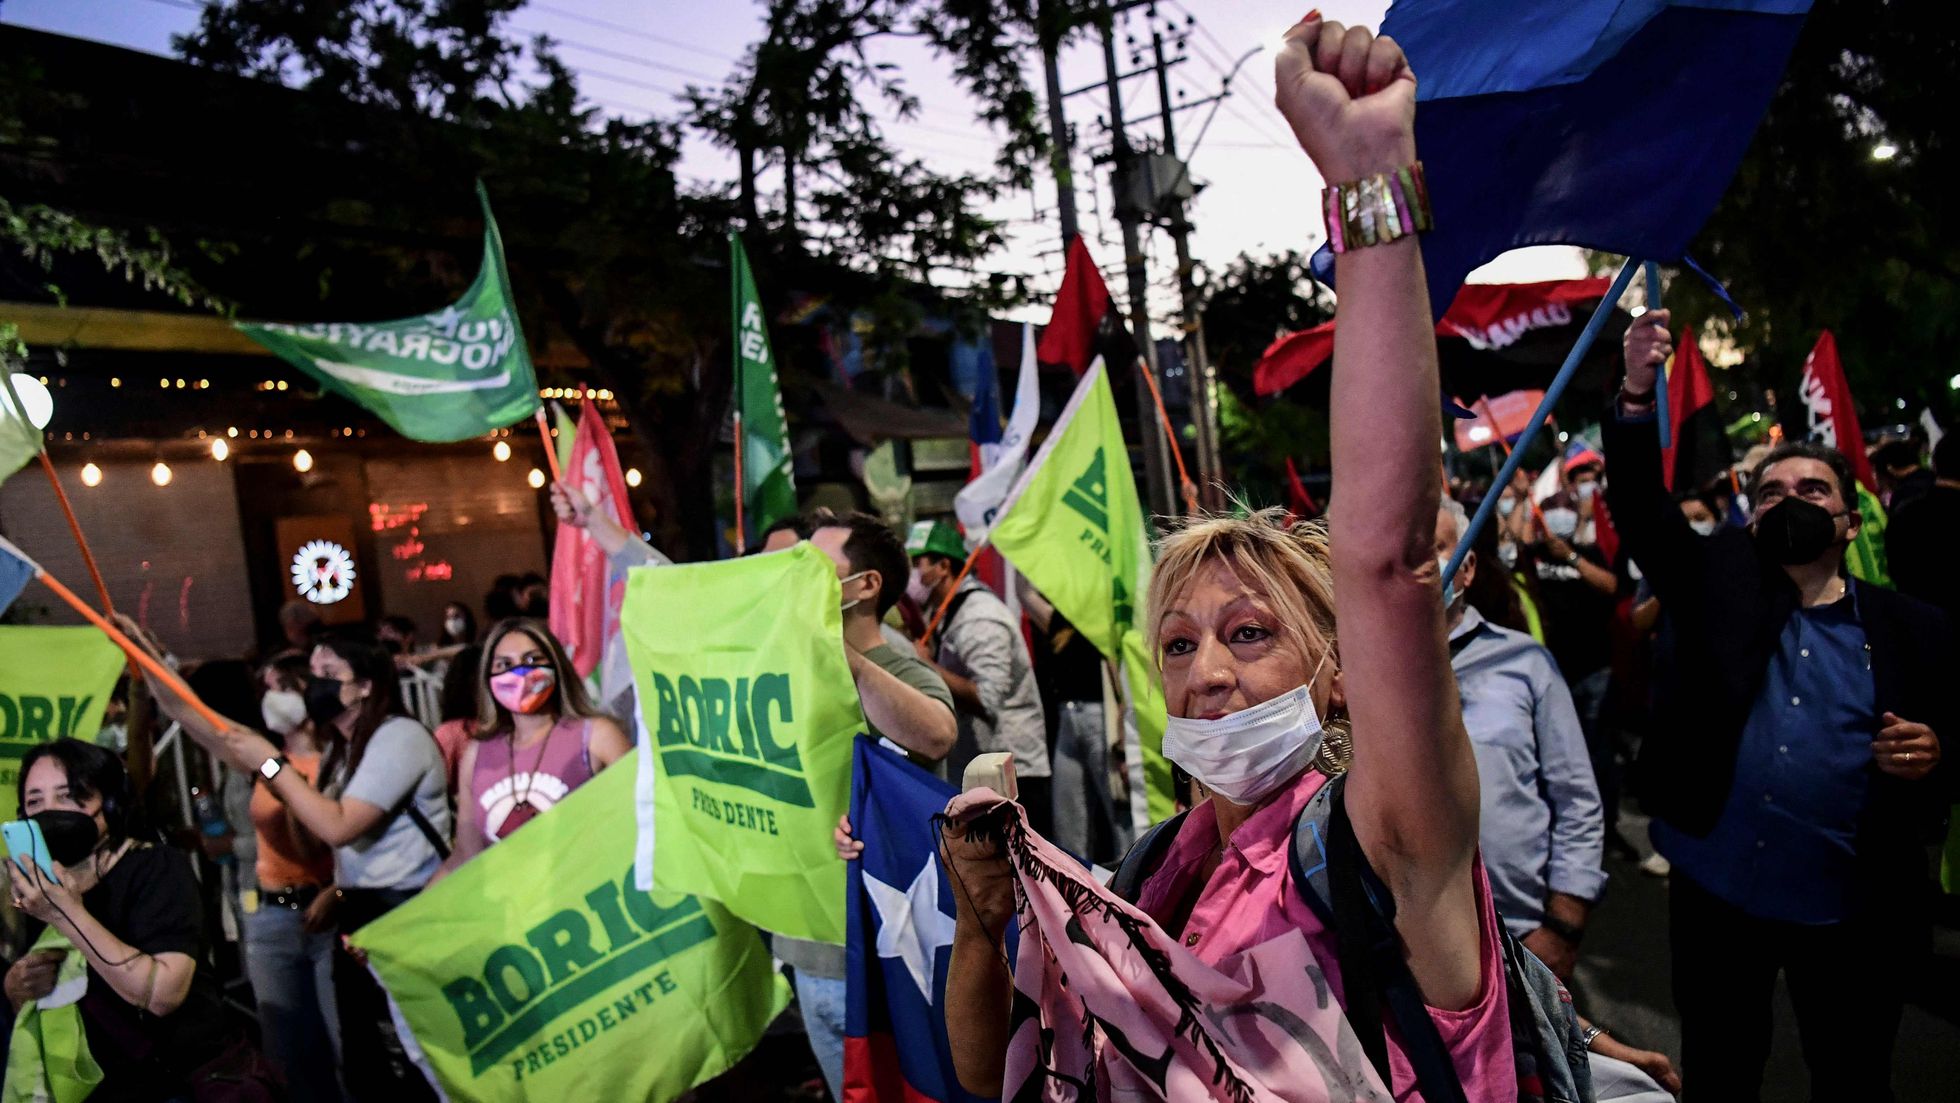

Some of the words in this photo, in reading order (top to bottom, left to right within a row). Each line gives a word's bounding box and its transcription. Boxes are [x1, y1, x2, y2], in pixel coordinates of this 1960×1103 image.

[652, 670, 804, 772] BORIC
[692, 787, 780, 836] PRESDENTE
[512, 970, 677, 1082] PRESIDENTE
